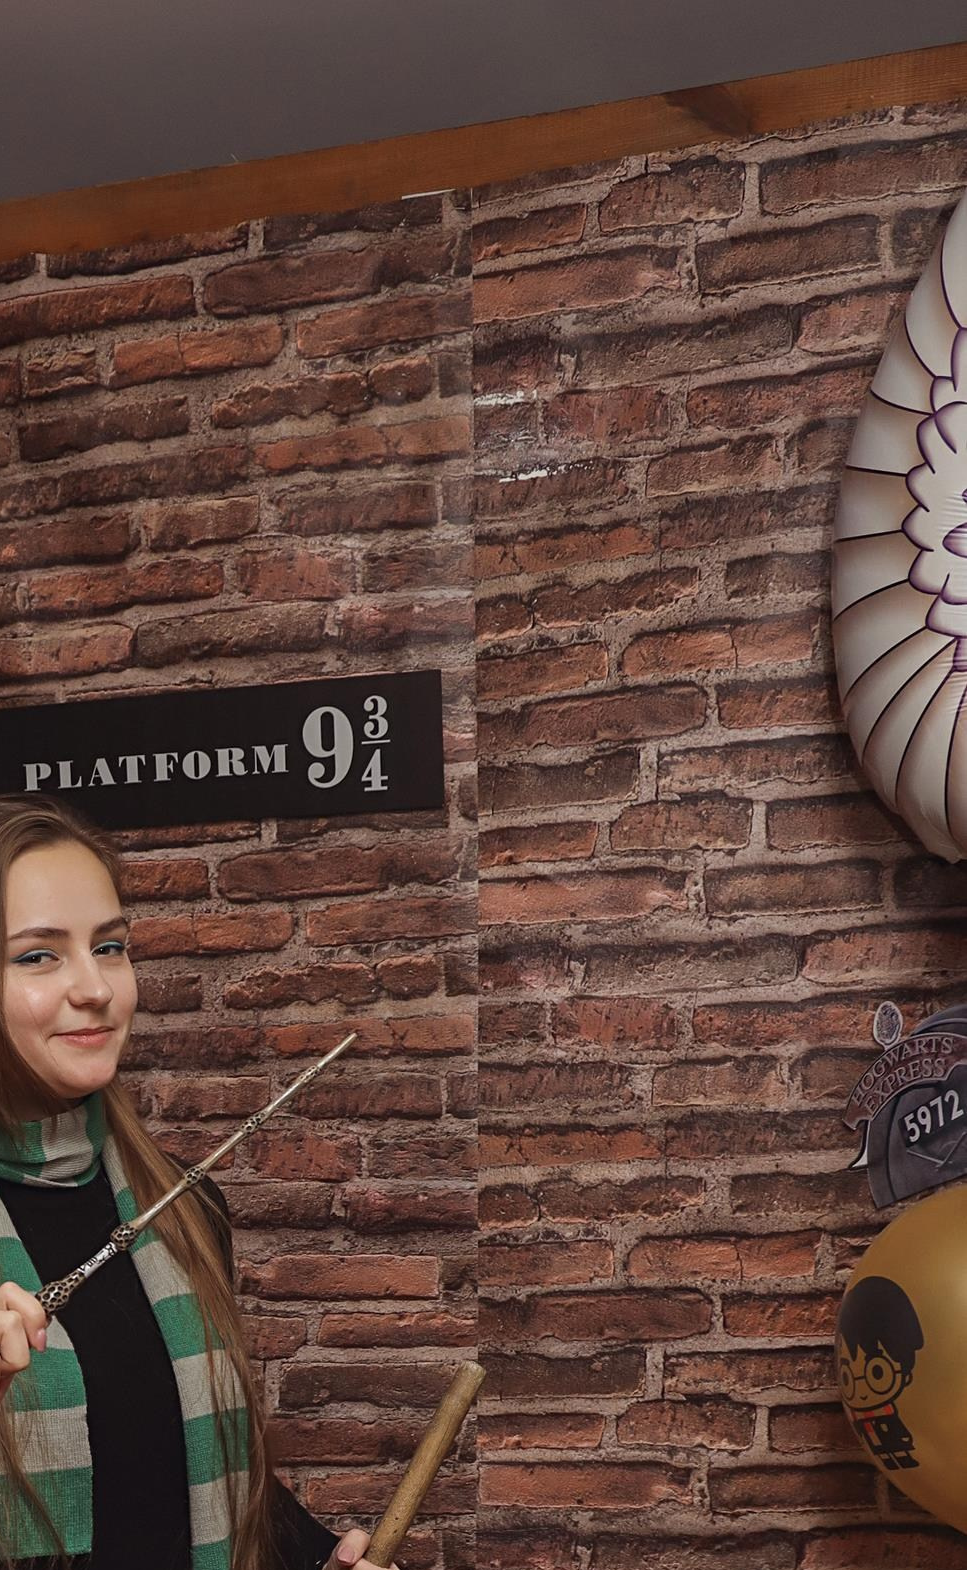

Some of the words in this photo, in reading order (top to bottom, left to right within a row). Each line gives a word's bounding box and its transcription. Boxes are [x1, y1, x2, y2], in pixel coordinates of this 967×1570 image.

[22, 743, 290, 792] PLATFORM
[851, 1037, 954, 1105] HOGWARTS
[864, 1057, 946, 1115] EXPRESS
[903, 1089, 965, 1143] 5972
